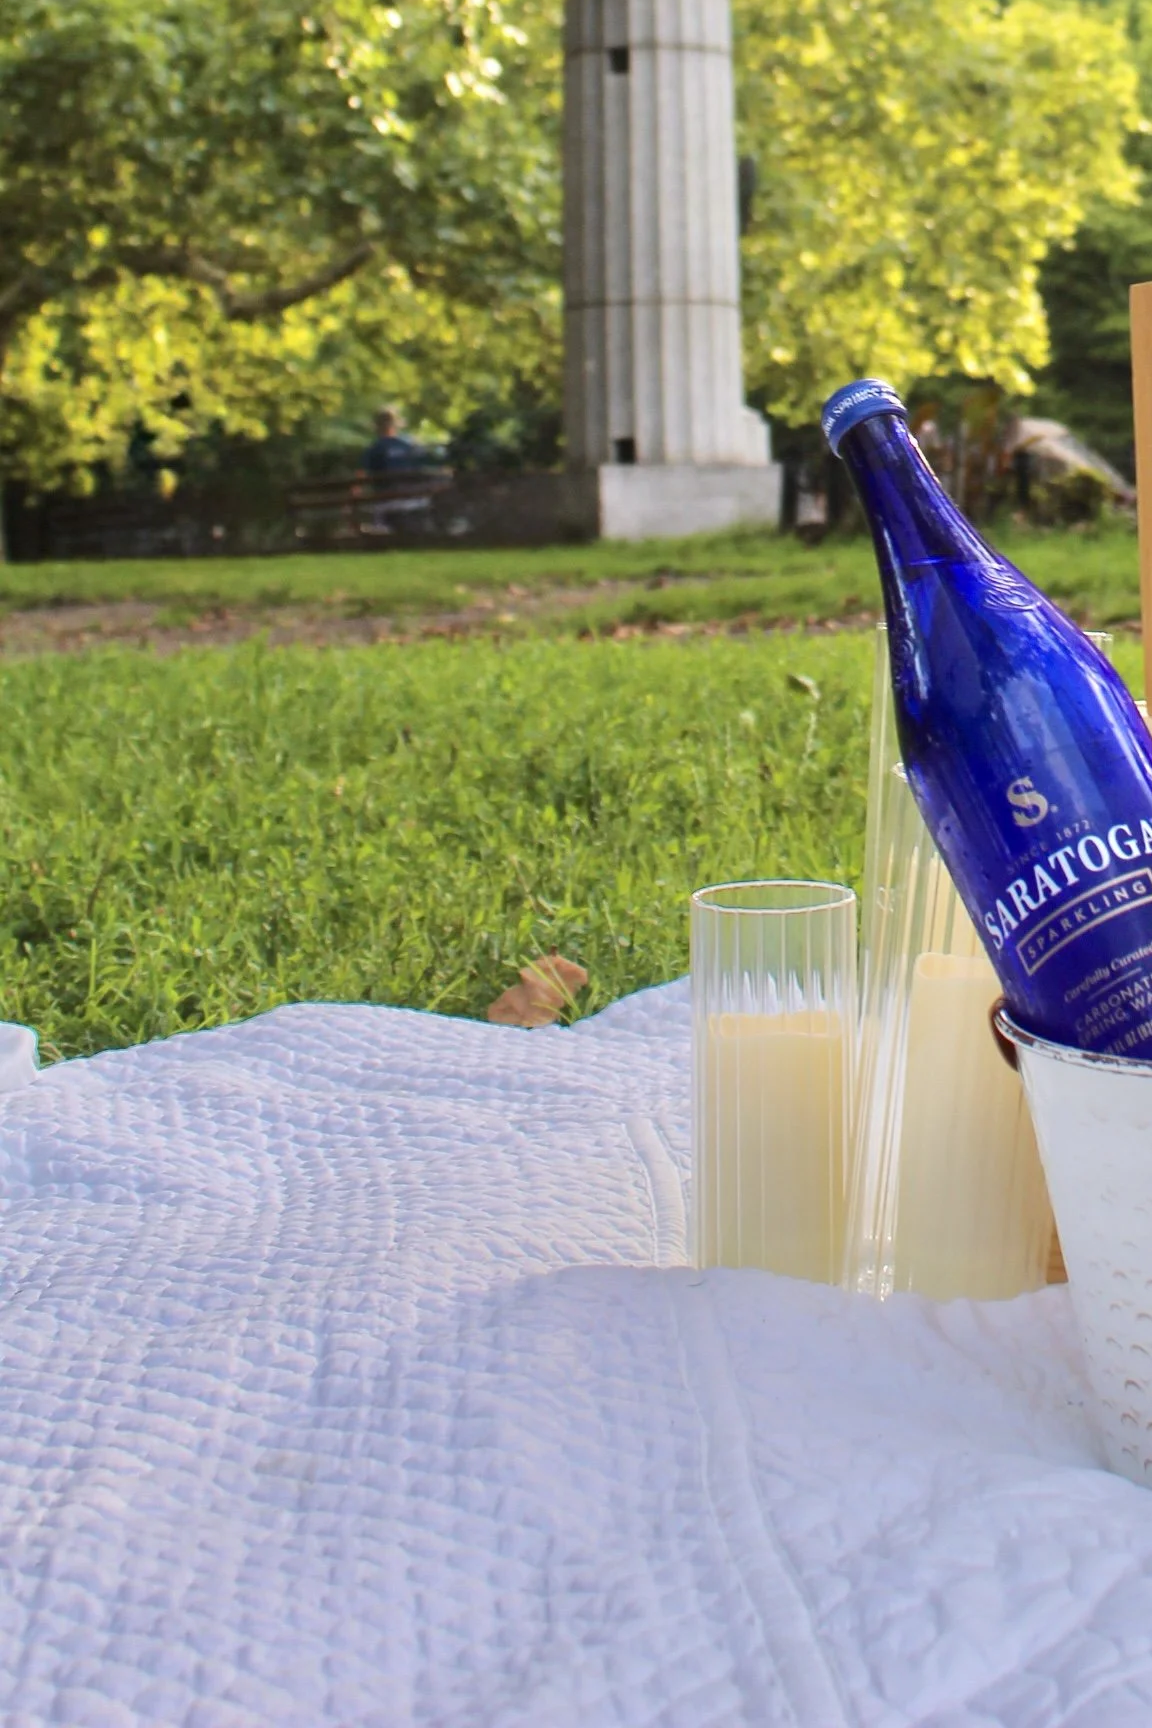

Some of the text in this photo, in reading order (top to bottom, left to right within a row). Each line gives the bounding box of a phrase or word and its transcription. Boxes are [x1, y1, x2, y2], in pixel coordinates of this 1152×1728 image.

[1007, 819, 1090, 874] SINCE 1872
[1027, 880, 1148, 959] SPARKLING
[1064, 966, 1111, 1003] Carefully
[1077, 1007, 1128, 1046] SPRING
